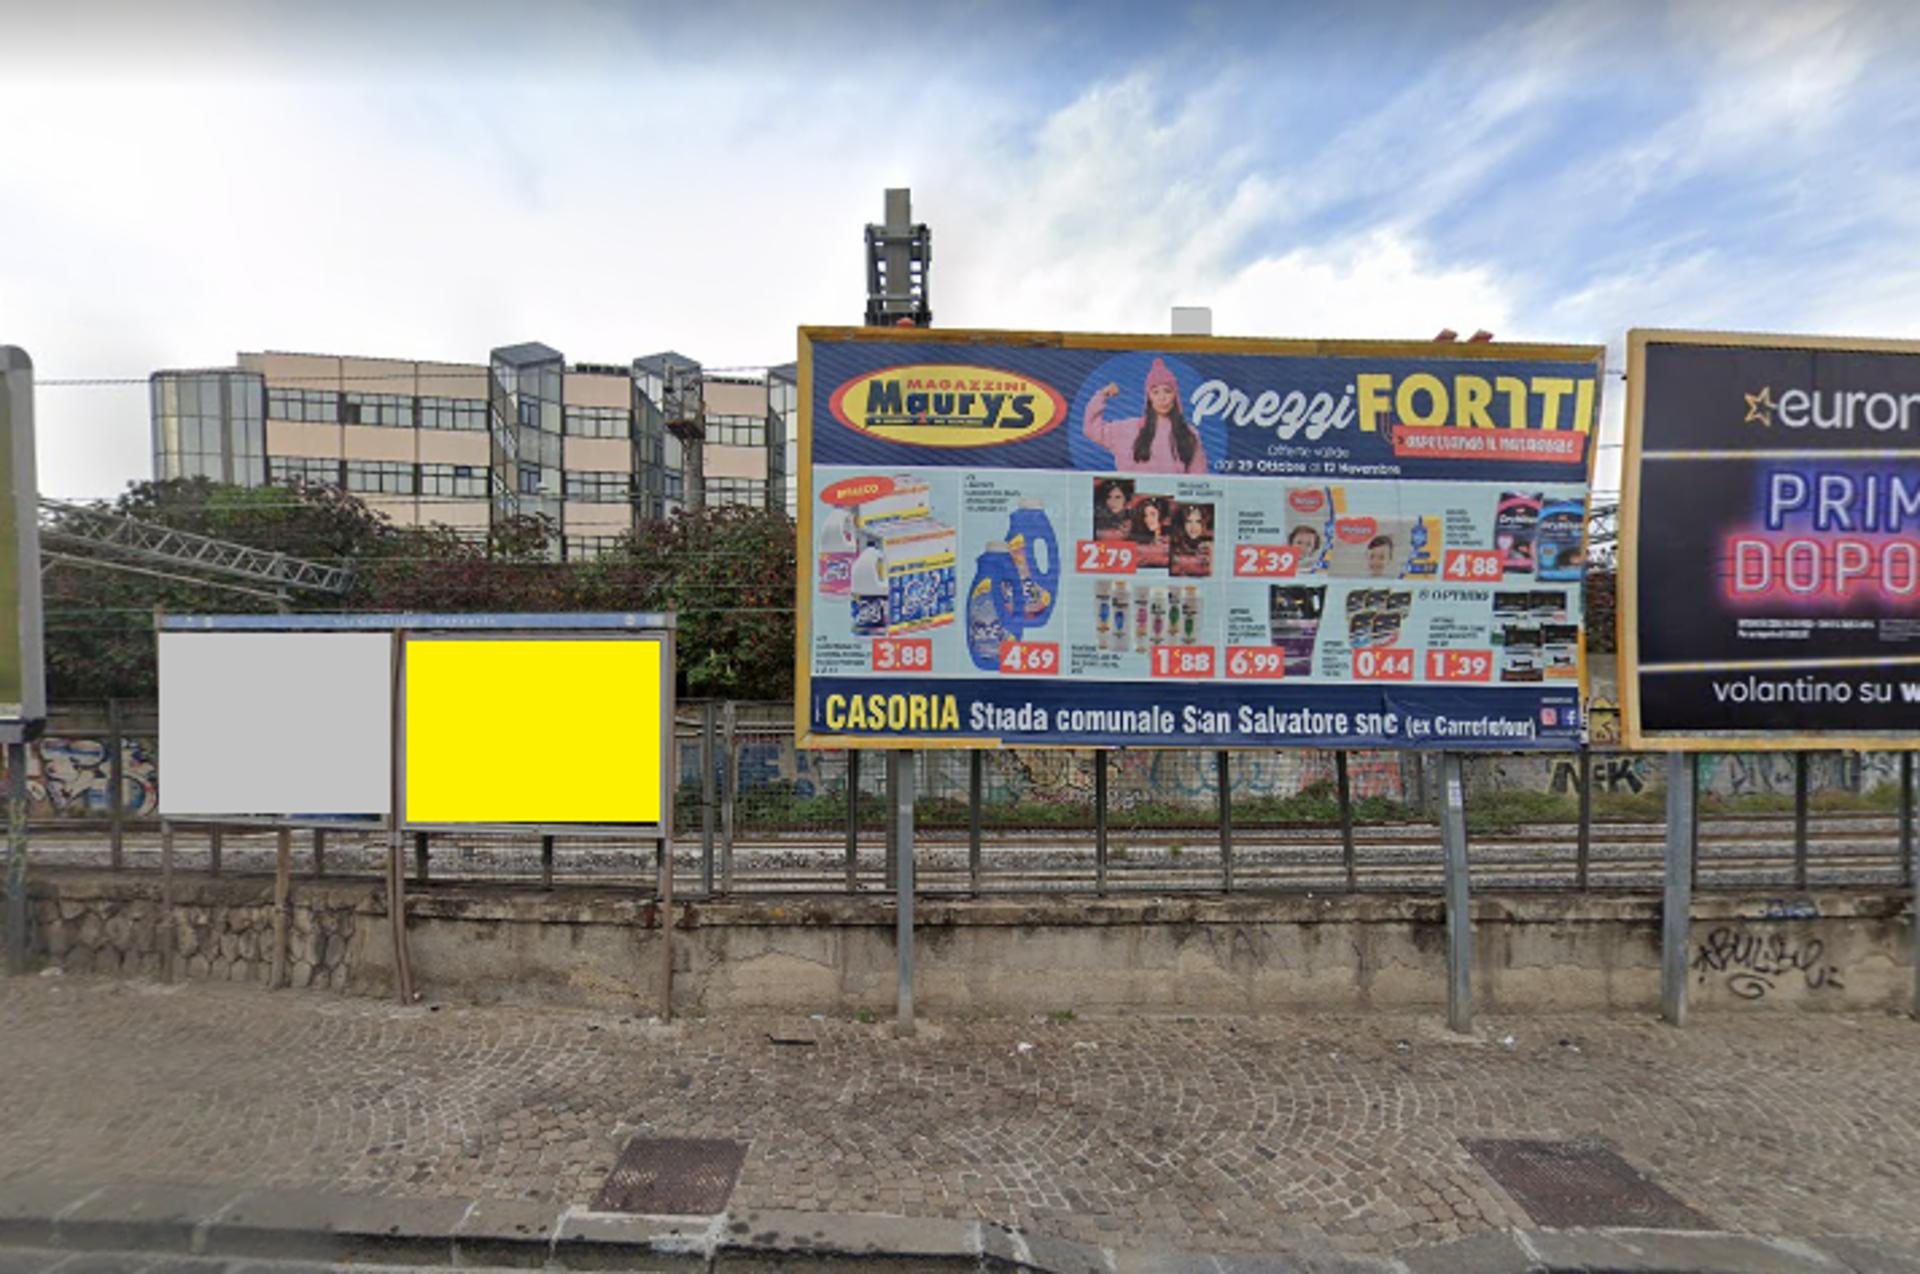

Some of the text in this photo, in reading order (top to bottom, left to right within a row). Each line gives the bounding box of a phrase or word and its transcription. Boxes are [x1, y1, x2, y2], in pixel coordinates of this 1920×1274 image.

[866, 380, 1035, 428] Maury's
[907, 379, 1027, 391] MAGAZZINI
[1191, 379, 1356, 441] Prezzi
[1734, 540, 1918, 595] DOPO
[1713, 677, 1851, 702] volantino
[1860, 683, 1892, 702] su
[825, 694, 961, 731] CASORIA
[1056, 705, 1175, 733] comunale
[1183, 705, 1231, 734] San
[1238, 705, 1348, 735] Salvatore
[1356, 713, 1399, 735] snc
[1405, 714, 1431, 738] (ex
